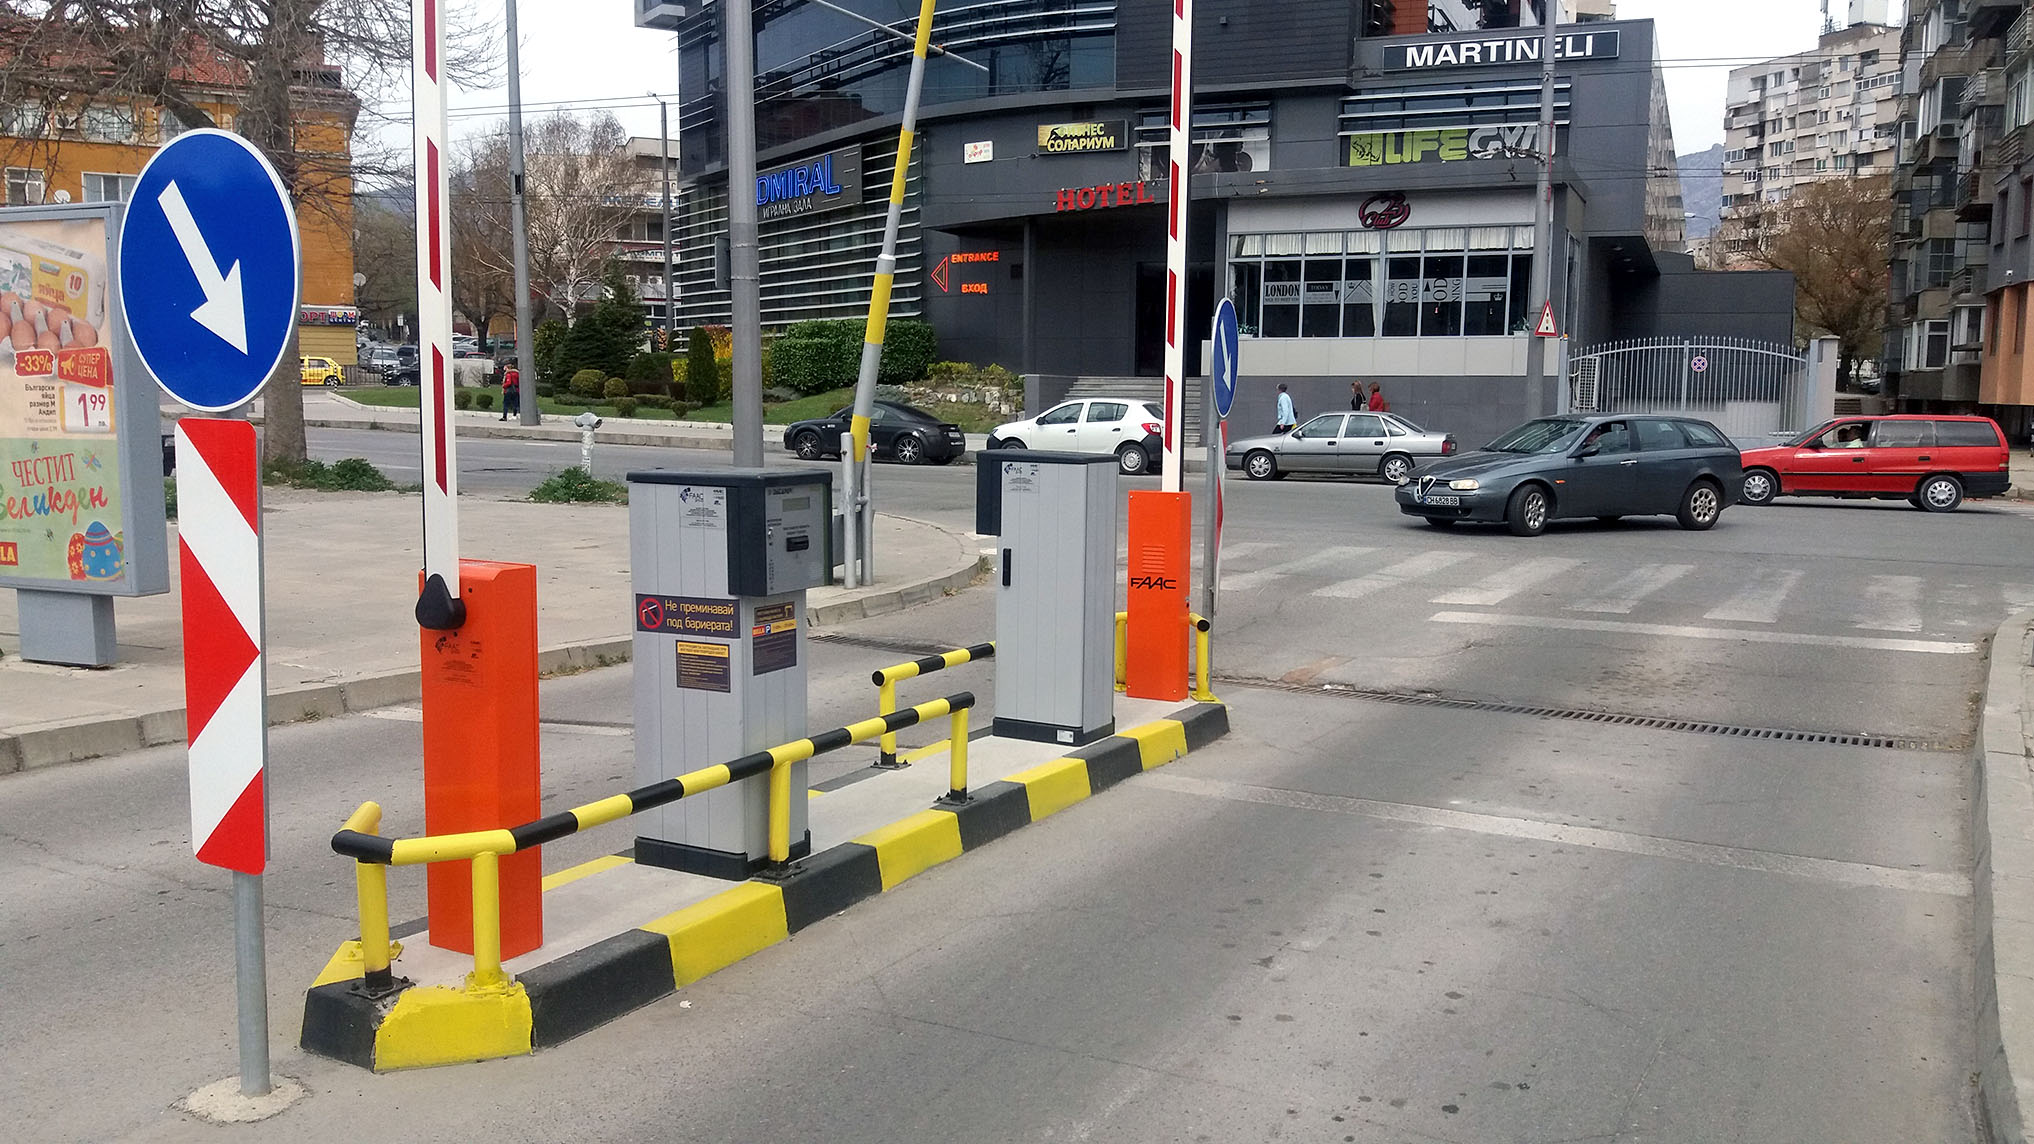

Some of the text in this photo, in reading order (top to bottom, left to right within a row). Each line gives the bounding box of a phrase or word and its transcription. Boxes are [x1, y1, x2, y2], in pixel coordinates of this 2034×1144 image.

[1047, 136, 1115, 152] СОЛАРИУМ
[1056, 181, 1155, 212] HOTEL
[951, 251, 999, 264] ENTRANCE
[69, 274, 82, 291] 10
[961, 283, 988, 295] ВХОД
[1265, 284, 1300, 297] LONDON
[20, 354, 52, 372] -33%
[78, 353, 101, 362] СУПЕР
[77, 365, 98, 379] ЦЕНА
[11, 453, 76, 487] ЧЕСТИТ
[1130, 576, 1177, 590] FAAC
[664, 599, 734, 616] Не преминавай
[666, 616, 733, 633] под бариерата!
